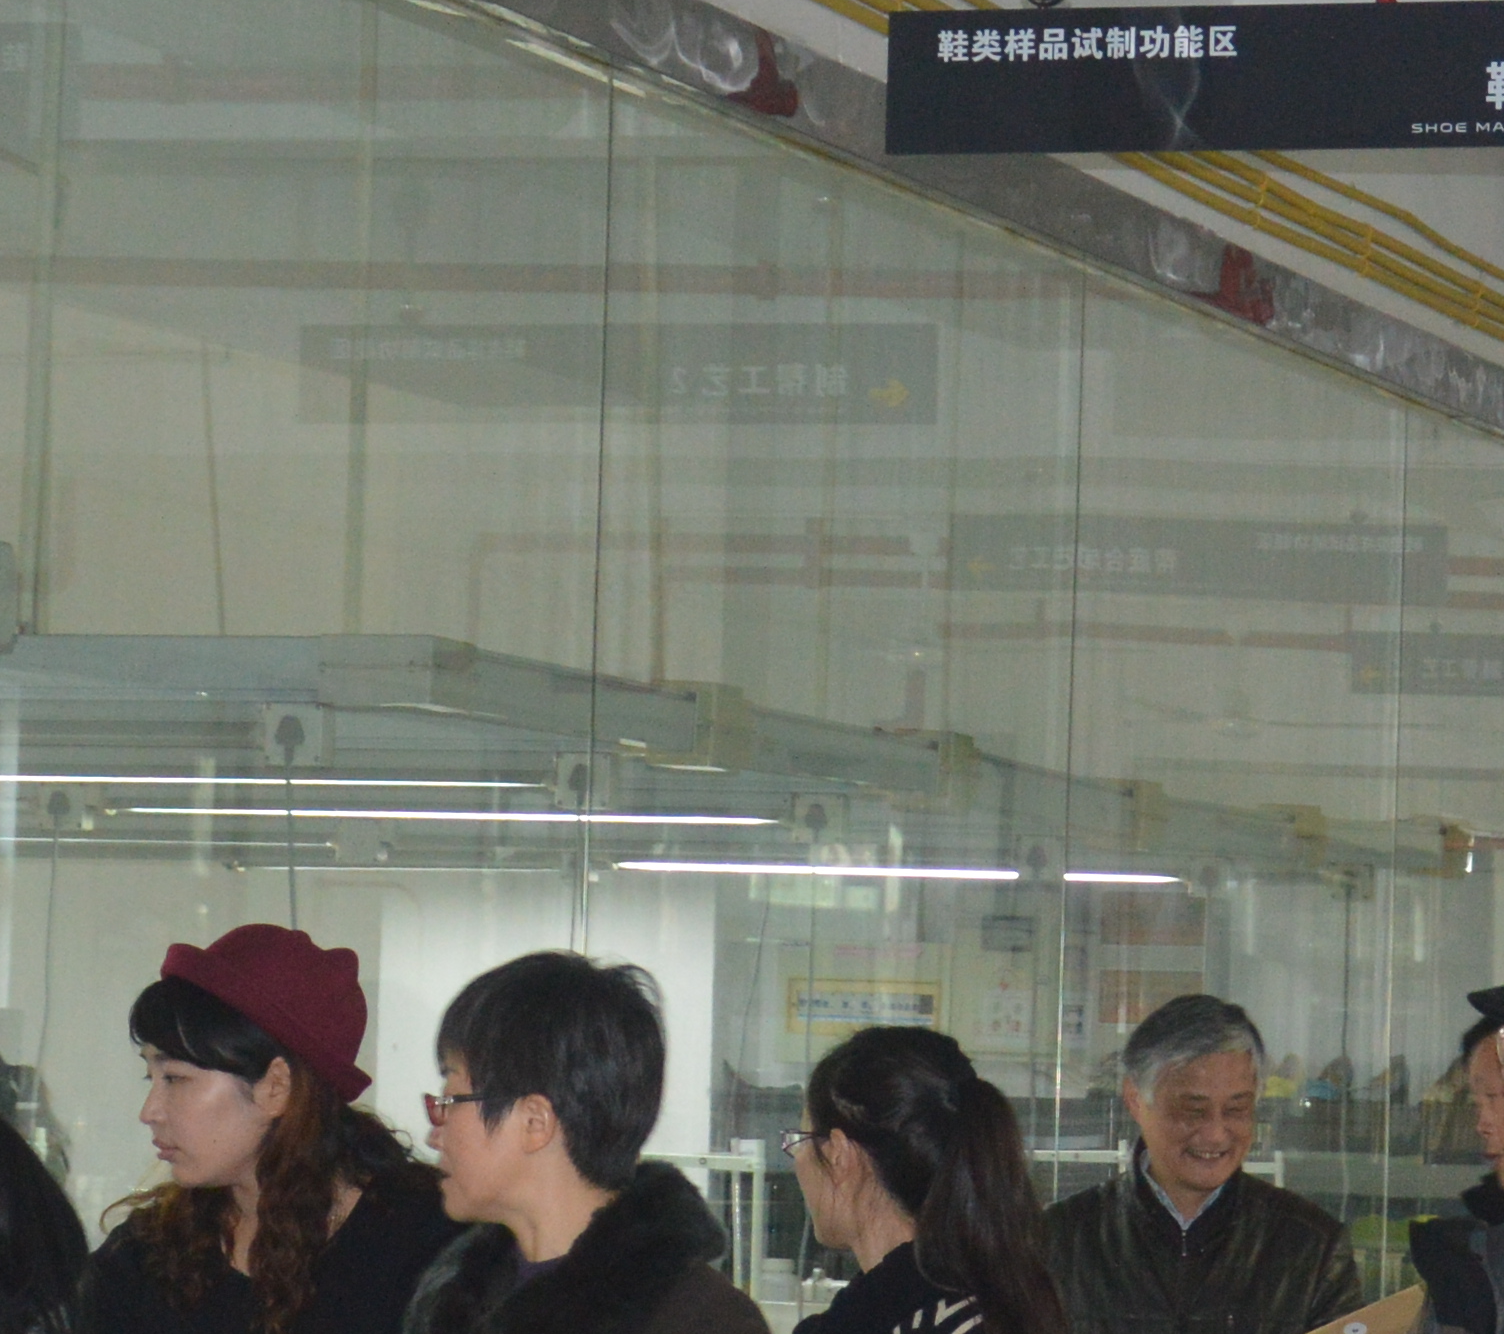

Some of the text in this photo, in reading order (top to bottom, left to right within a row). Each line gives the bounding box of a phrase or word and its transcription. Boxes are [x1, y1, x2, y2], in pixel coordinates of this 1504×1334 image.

[937, 24, 1238, 63] 鞋类样品试制功能区
[1411, 122, 1467, 134] SHOE
